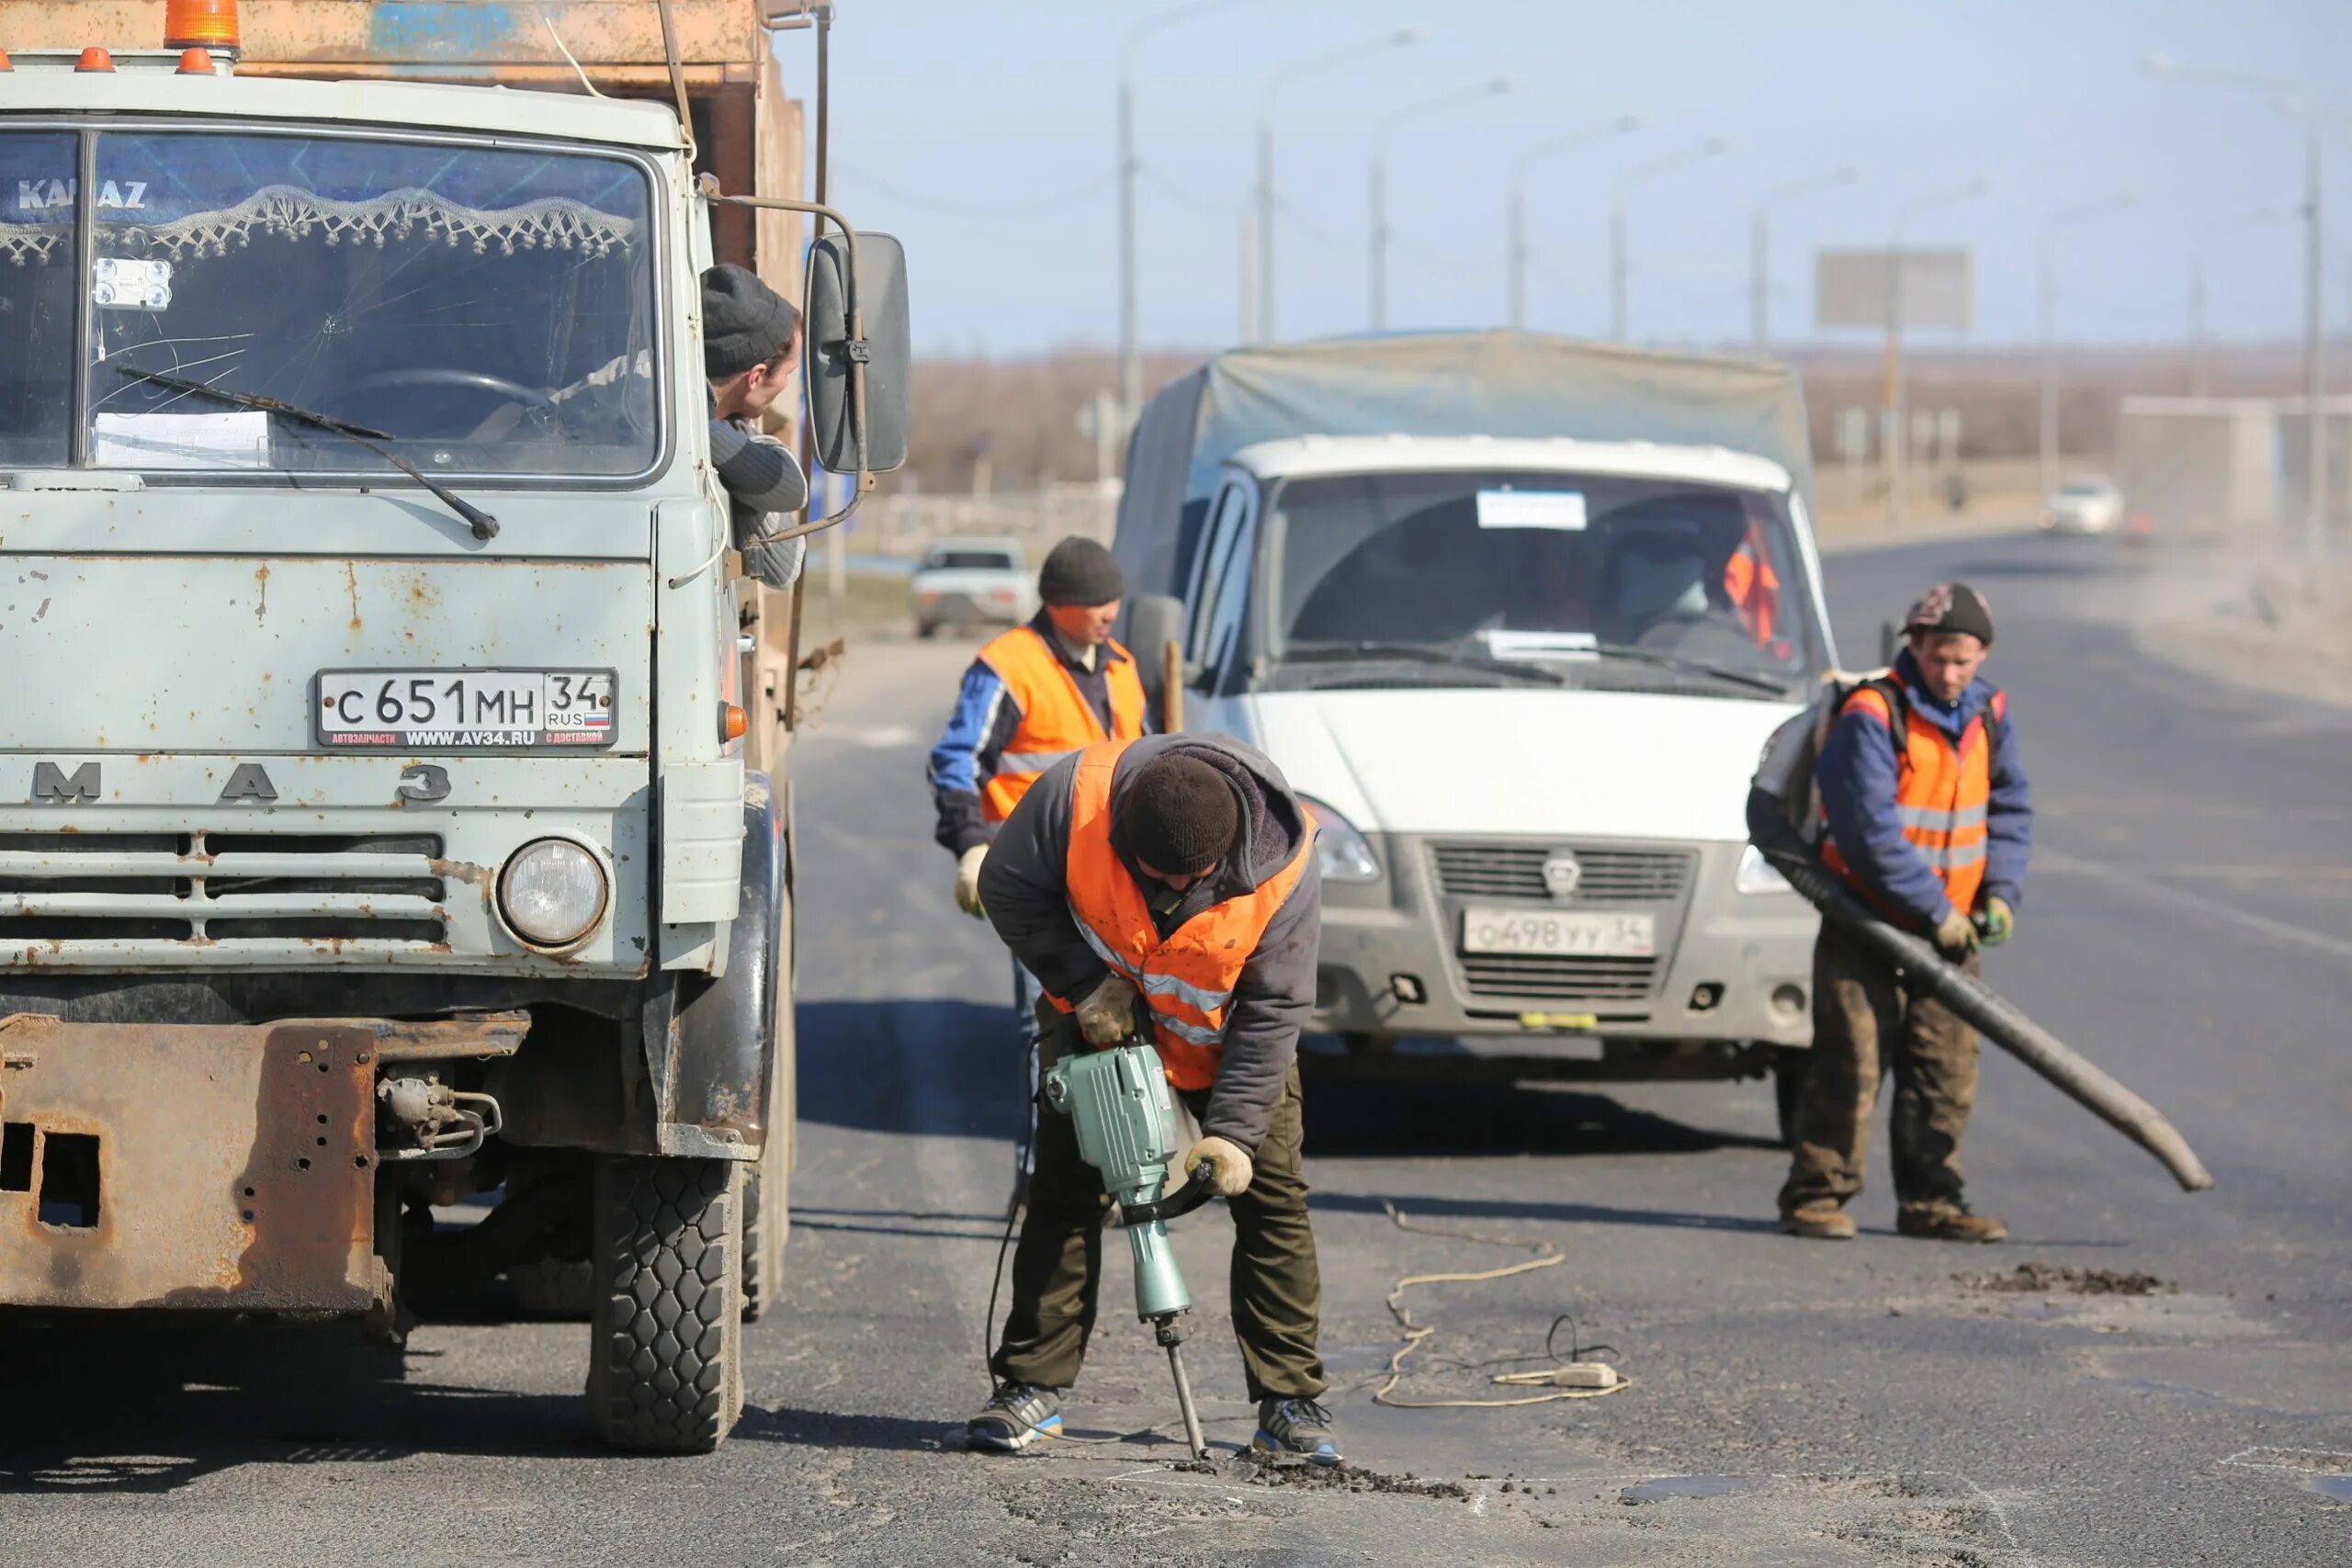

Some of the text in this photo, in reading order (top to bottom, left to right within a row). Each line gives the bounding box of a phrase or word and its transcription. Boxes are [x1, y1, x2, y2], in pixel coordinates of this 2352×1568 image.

[551, 676, 596, 710] 34
[548, 714, 582, 726] RUS
[406, 732, 536, 745] WWW.AV34.RU
